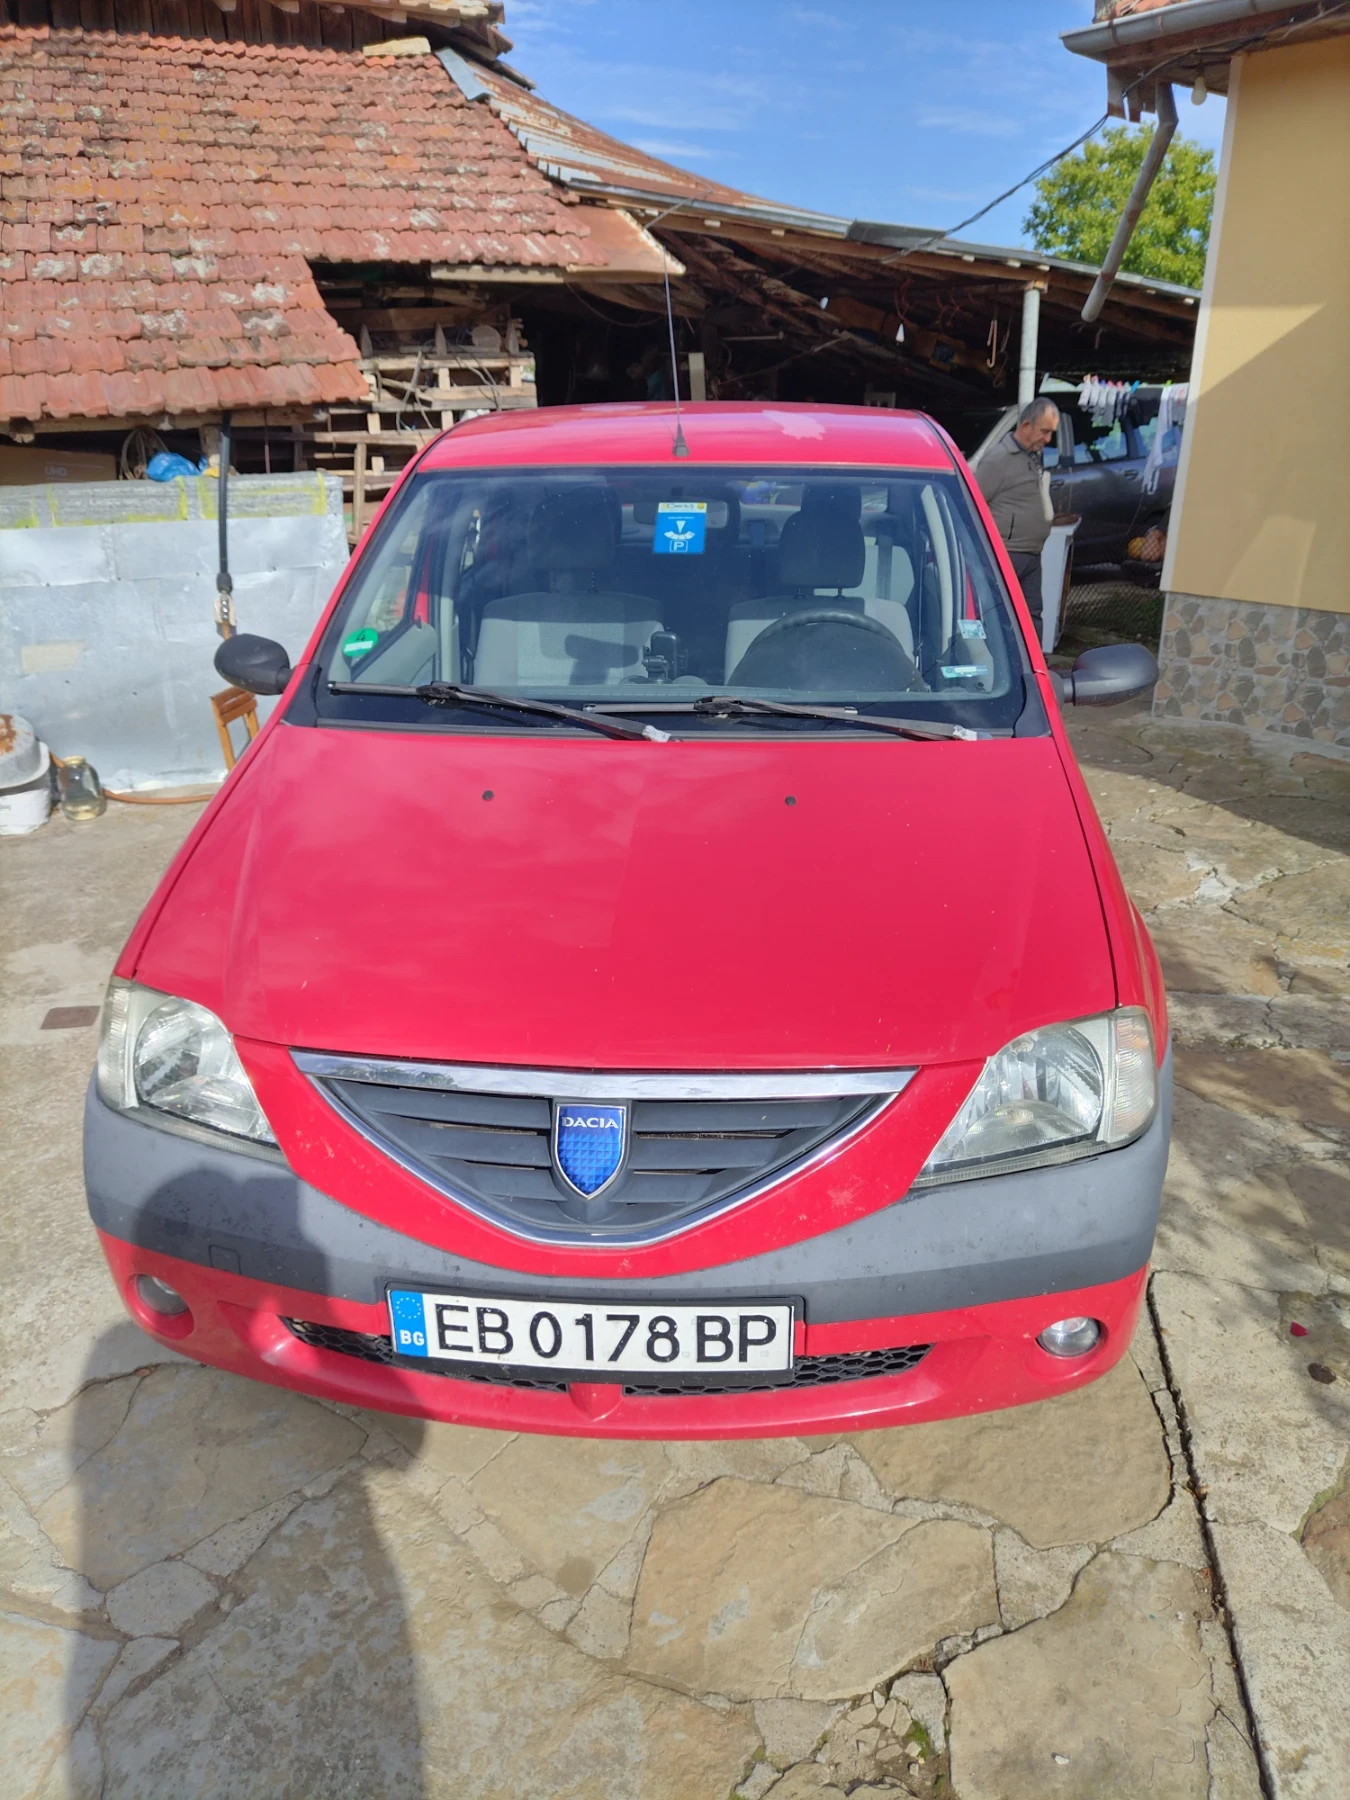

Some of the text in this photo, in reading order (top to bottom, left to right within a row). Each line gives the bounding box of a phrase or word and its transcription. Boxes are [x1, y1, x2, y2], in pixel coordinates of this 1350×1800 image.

[673, 541, 685, 551] P
[355, 629, 367, 642] 4
[561, 1116, 619, 1129] DACIA
[400, 1329, 425, 1346] BG
[435, 1303, 777, 1363] EB 0178 BP
